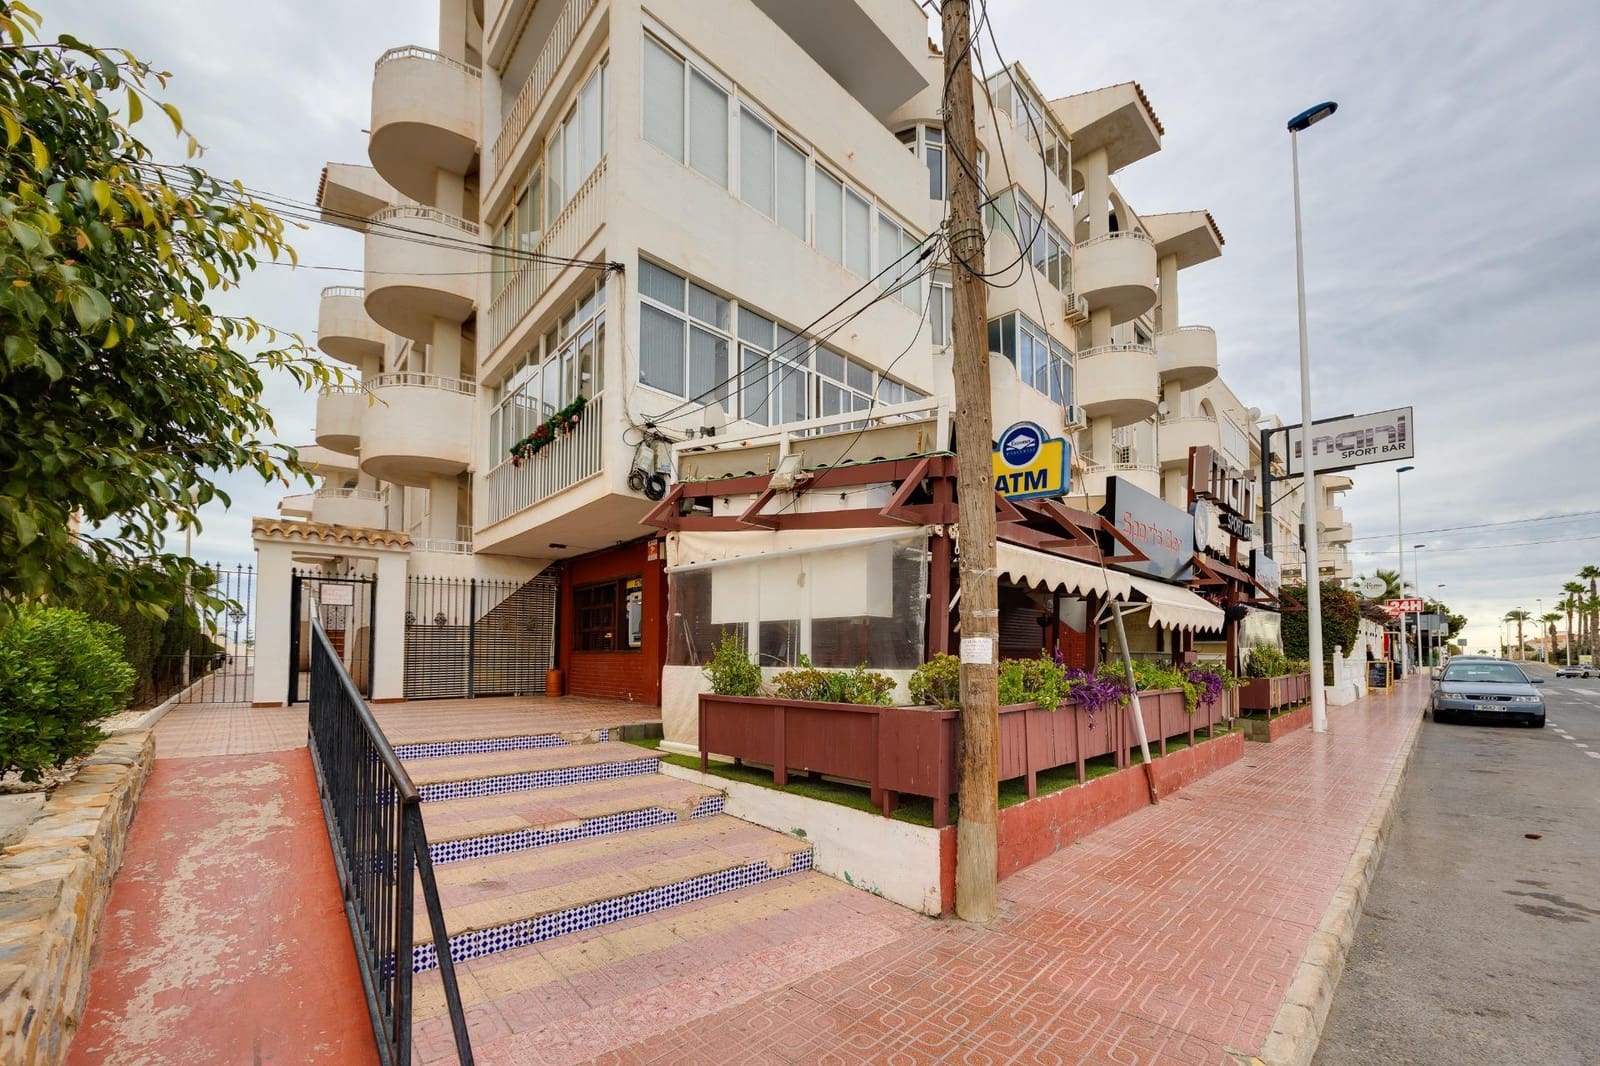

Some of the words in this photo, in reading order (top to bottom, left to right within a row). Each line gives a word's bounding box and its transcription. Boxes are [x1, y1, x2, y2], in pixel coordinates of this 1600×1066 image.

[1341, 446, 1378, 459] SPORT
[1381, 442, 1406, 454] BAR
[994, 468, 1048, 494] ATM
